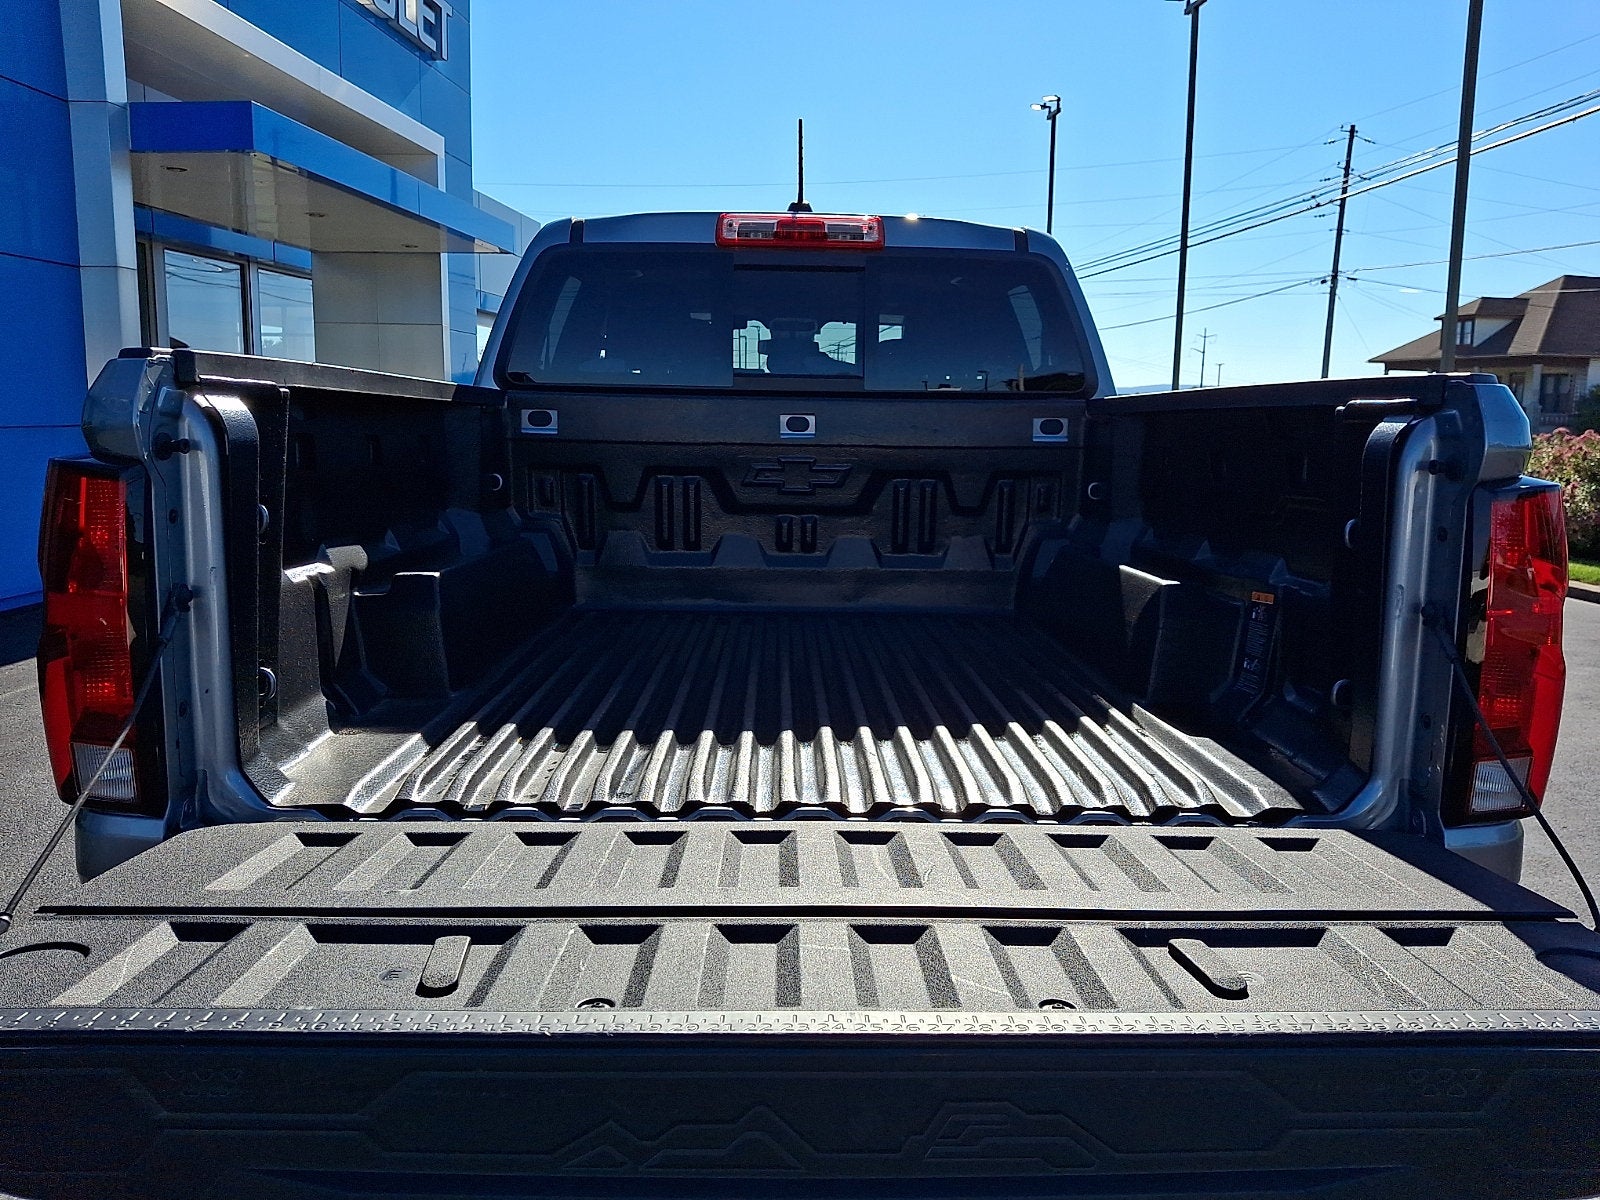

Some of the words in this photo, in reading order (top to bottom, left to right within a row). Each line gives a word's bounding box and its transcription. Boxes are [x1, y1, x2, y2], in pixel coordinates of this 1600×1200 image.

[228, 1021, 247, 1029] 8
[295, 1021, 329, 1030] 10
[408, 1022, 440, 1030] 13
[444, 1022, 476, 1030] 14
[481, 1023, 513, 1031] 15
[518, 1023, 550, 1031] 16
[557, 1023, 588, 1031] 17
[595, 1023, 625, 1031] 18
[632, 1023, 663, 1031] 19
[670, 1023, 700, 1031] 20
[706, 1023, 737, 1031] 21
[743, 1023, 773, 1031] 22
[780, 1023, 810, 1031] 23
[816, 1023, 846, 1031] 24
[854, 1023, 884, 1031] 25
[890, 1023, 920, 1031] 26
[927, 1023, 956, 1031] 27
[963, 1023, 994, 1031] 28
[999, 1023, 1030, 1031] 29
[1035, 1023, 1066, 1031] 30
[1072, 1023, 1100, 1031] 31
[1108, 1023, 1137, 1031] 32
[1144, 1023, 1176, 1031] 33
[1216, 1023, 1246, 1031] 35
[1251, 1023, 1282, 1031] 36
[1322, 1022, 1353, 1030] 38
[1357, 1022, 1388, 1030] 39
[1395, 1021, 1424, 1030] 40
[1431, 1021, 1461, 1030] 41
[1466, 1021, 1497, 1030] 42
